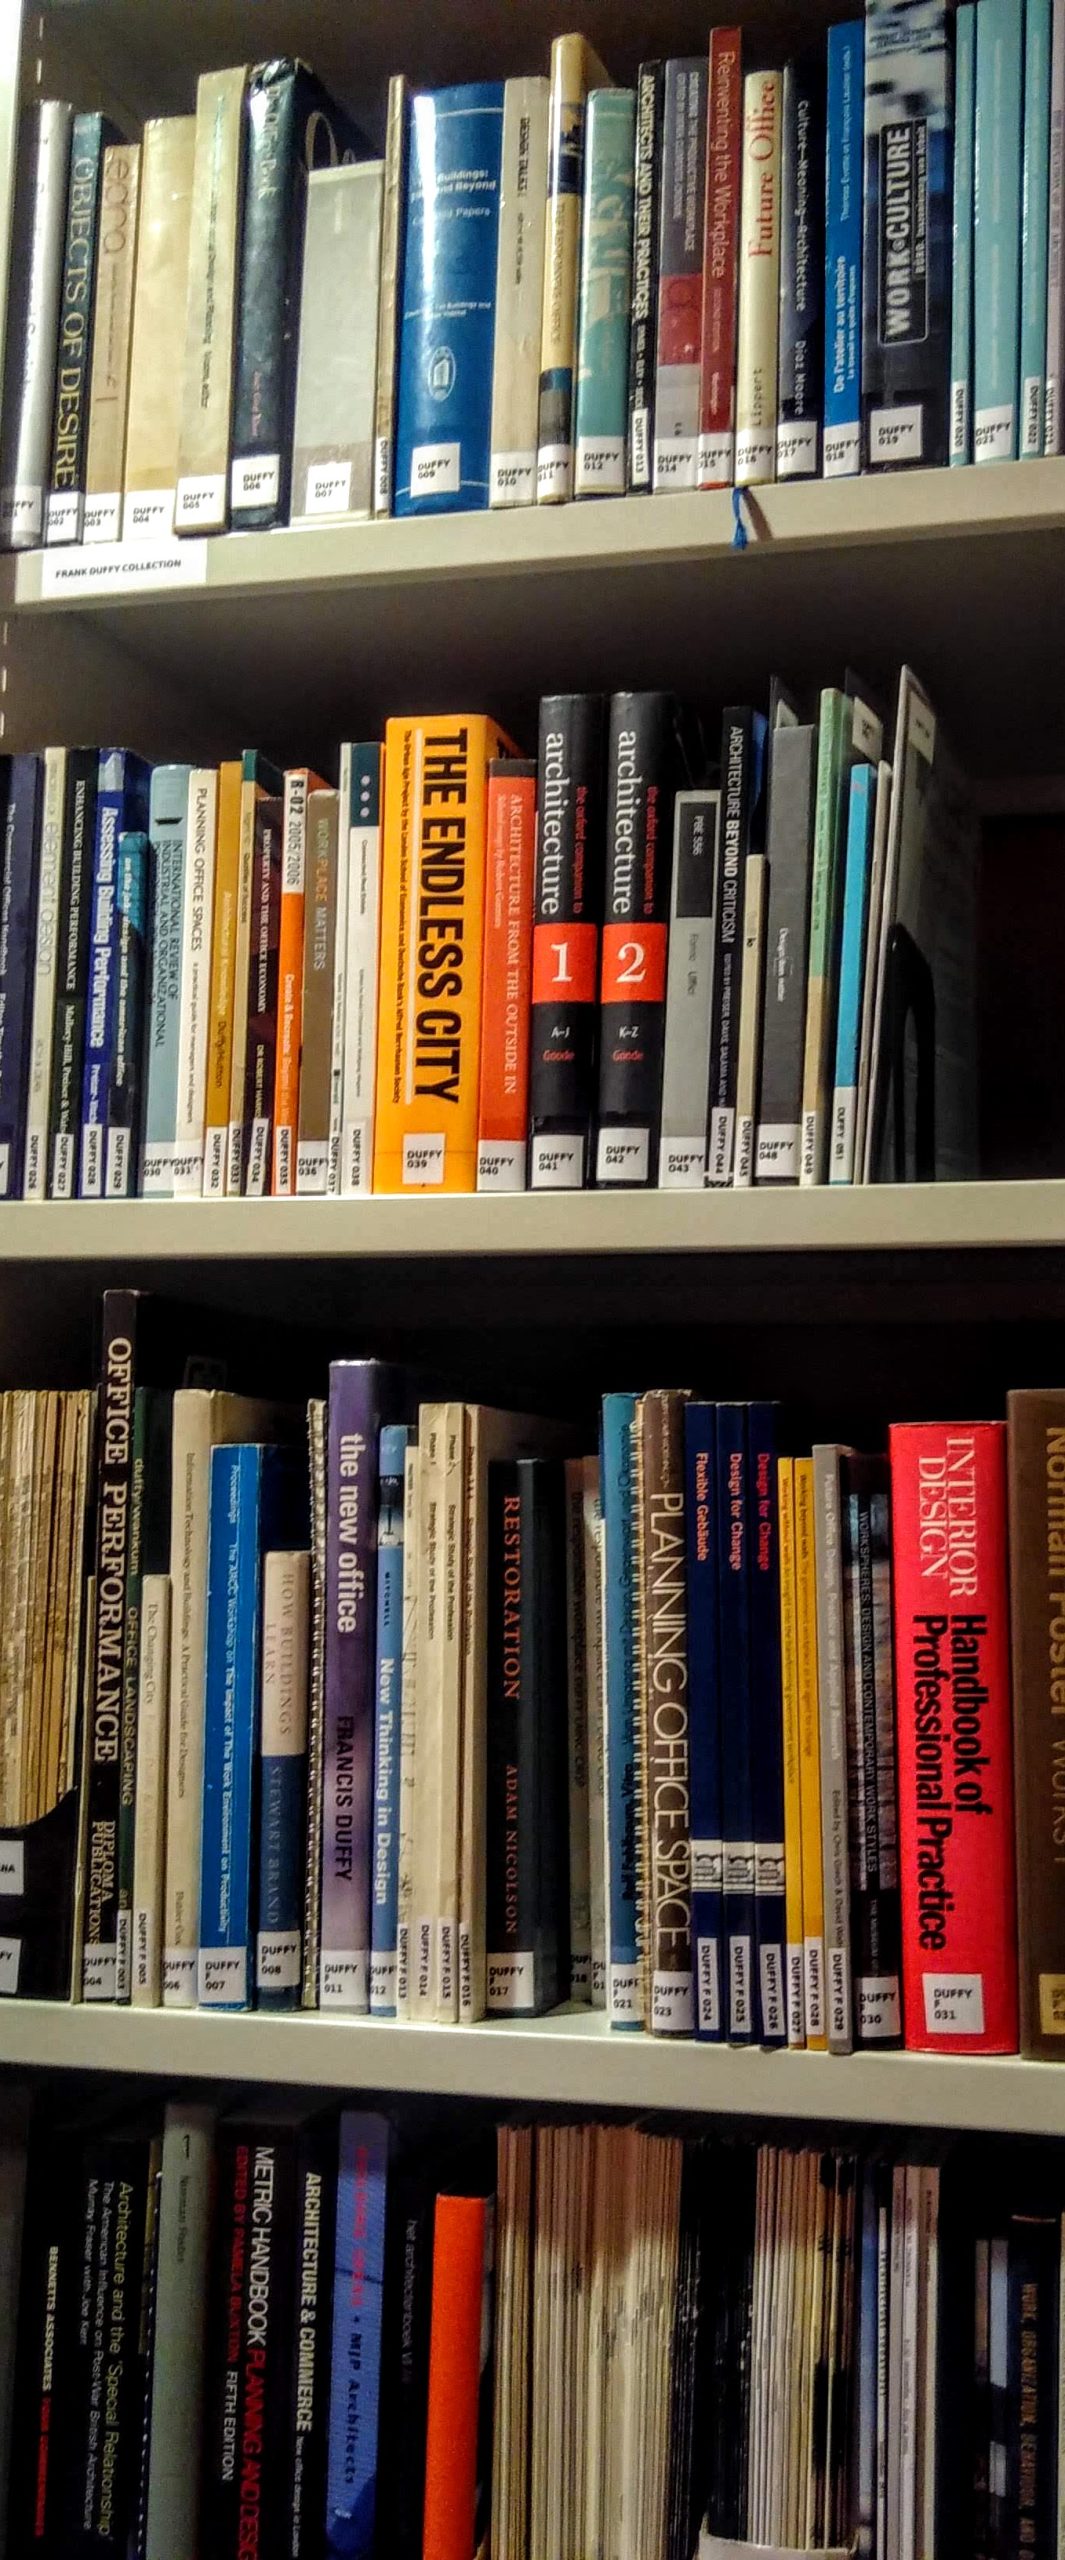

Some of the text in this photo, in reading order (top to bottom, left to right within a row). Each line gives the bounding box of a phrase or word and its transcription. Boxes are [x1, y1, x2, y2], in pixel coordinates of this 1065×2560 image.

[633, 74, 655, 320] ARCHITECTS AND THEIR PRACTICES
[710, 50, 735, 279] Reinventing the Workplace
[744, 80, 776, 257] Future Office
[54, 157, 95, 490] OBJECTS OF DESIRE
[836, 310, 845, 326] au
[794, 373, 806, 416] Moore
[833, 375, 845, 394] De
[879, 424, 914, 436] DUFFY
[879, 435, 898, 445] 019
[418, 459, 450, 471] DUFFY
[418, 470, 435, 479] 009
[55, 560, 182, 579] FRANK DUFFY COLLECTION
[286, 821, 304, 887] 2005/2006
[540, 732, 571, 915] architecture
[612, 730, 643, 915] architecture
[721, 725, 744, 944] ARCHITECTURE BEYOND CRITICISM
[65, 779, 86, 991] ENHANCING BUILDING PERFORMANCE
[123, 873, 132, 889] the
[160, 842, 172, 910] INDUSTRIAL
[191, 788, 208, 952] PLANNING OFFICE SPACES
[313, 818, 330, 971] WORKPLACE MATTERS
[90, 807, 119, 1049] Assessing Building Performance
[119, 915, 131, 954] design
[158, 913, 169, 933] AND
[167, 840, 183, 1000] INTERNATIONAL REVIEW OF
[415, 727, 467, 1104] THE ENDLESS CITY
[504, 793, 523, 1095] ARCHITECTURE FROM THE OUTSIDE IN
[119, 978, 128, 997] the
[120, 955, 129, 977] and
[154, 935, 168, 1048] ORGANIZATIONAL
[550, 942, 573, 983] 1
[616, 942, 646, 983] 2
[117, 1000, 127, 1053] american
[115, 1054, 125, 1087] office
[251, 1126, 265, 1184] DUFFY 034
[407, 1150, 442, 1160] DUFFY
[407, 1160, 427, 1169] 039
[539, 1153, 574, 1162] DUFFY
[539, 1162, 557, 1171] 041
[759, 1141, 794, 1150] DUFFY
[759, 1151, 777, 1160] 048
[695, 1452, 709, 1562] Flexible Gebäude
[727, 1453, 744, 1572] Design for Change
[756, 1453, 771, 1572] Design for Change
[918, 1456, 949, 1579] DESIGN
[946, 1436, 978, 1598] INTERIOR
[94, 1337, 132, 1763] OFFICE PERFORMANCE
[265, 1624, 277, 1686] LEARN
[278, 1573, 294, 1736] HOW BUILDINGS
[334, 1432, 366, 1882] the new office FRANCIS DUFFY
[121, 1607, 138, 1807] OFFICE LANDSCAPING
[503, 1495, 521, 1934] RESTORATION ADAM NICOLSON
[649, 1493, 691, 1948] PLANNING OFFICE SPACE
[950, 1614, 992, 1815] Handbook of
[373, 1658, 395, 1905] New Thinking in Design
[912, 1614, 955, 1951] Professional Practice
[100, 1820, 116, 1902] DIPLOMA
[267, 1765, 283, 1924] STEWART BRAND
[205, 1961, 240, 1971] DUFFY
[205, 1980, 225, 1990] 007
[934, 1989, 972, 1999] DUFFY
[934, 2000, 940, 2008] F
[934, 2009, 956, 2020] 031
[102, 2181, 115, 2205] The
[98, 2207, 113, 2266] American
[112, 2181, 134, 2284] Architecture
[46, 2246, 59, 2311] BENNETTS
[95, 2269, 109, 2327] Influence
[111, 2288, 125, 2321] and
[295, 2172, 322, 2432] ARCHITECTURE & COMMERCE
[42, 2313, 55, 2392] ASSOCIATES
[94, 2330, 105, 2346] on
[110, 2326, 124, 2354] the
[240, 2146, 275, 2502] METRIC HANDBOOK PLANNING AND
[87, 2409, 102, 2450] British
[221, 2370, 238, 2481] FIFTH EDITION
[345, 2332, 362, 2485] MJP Architects
[83, 2452, 99, 2530] Architecture
